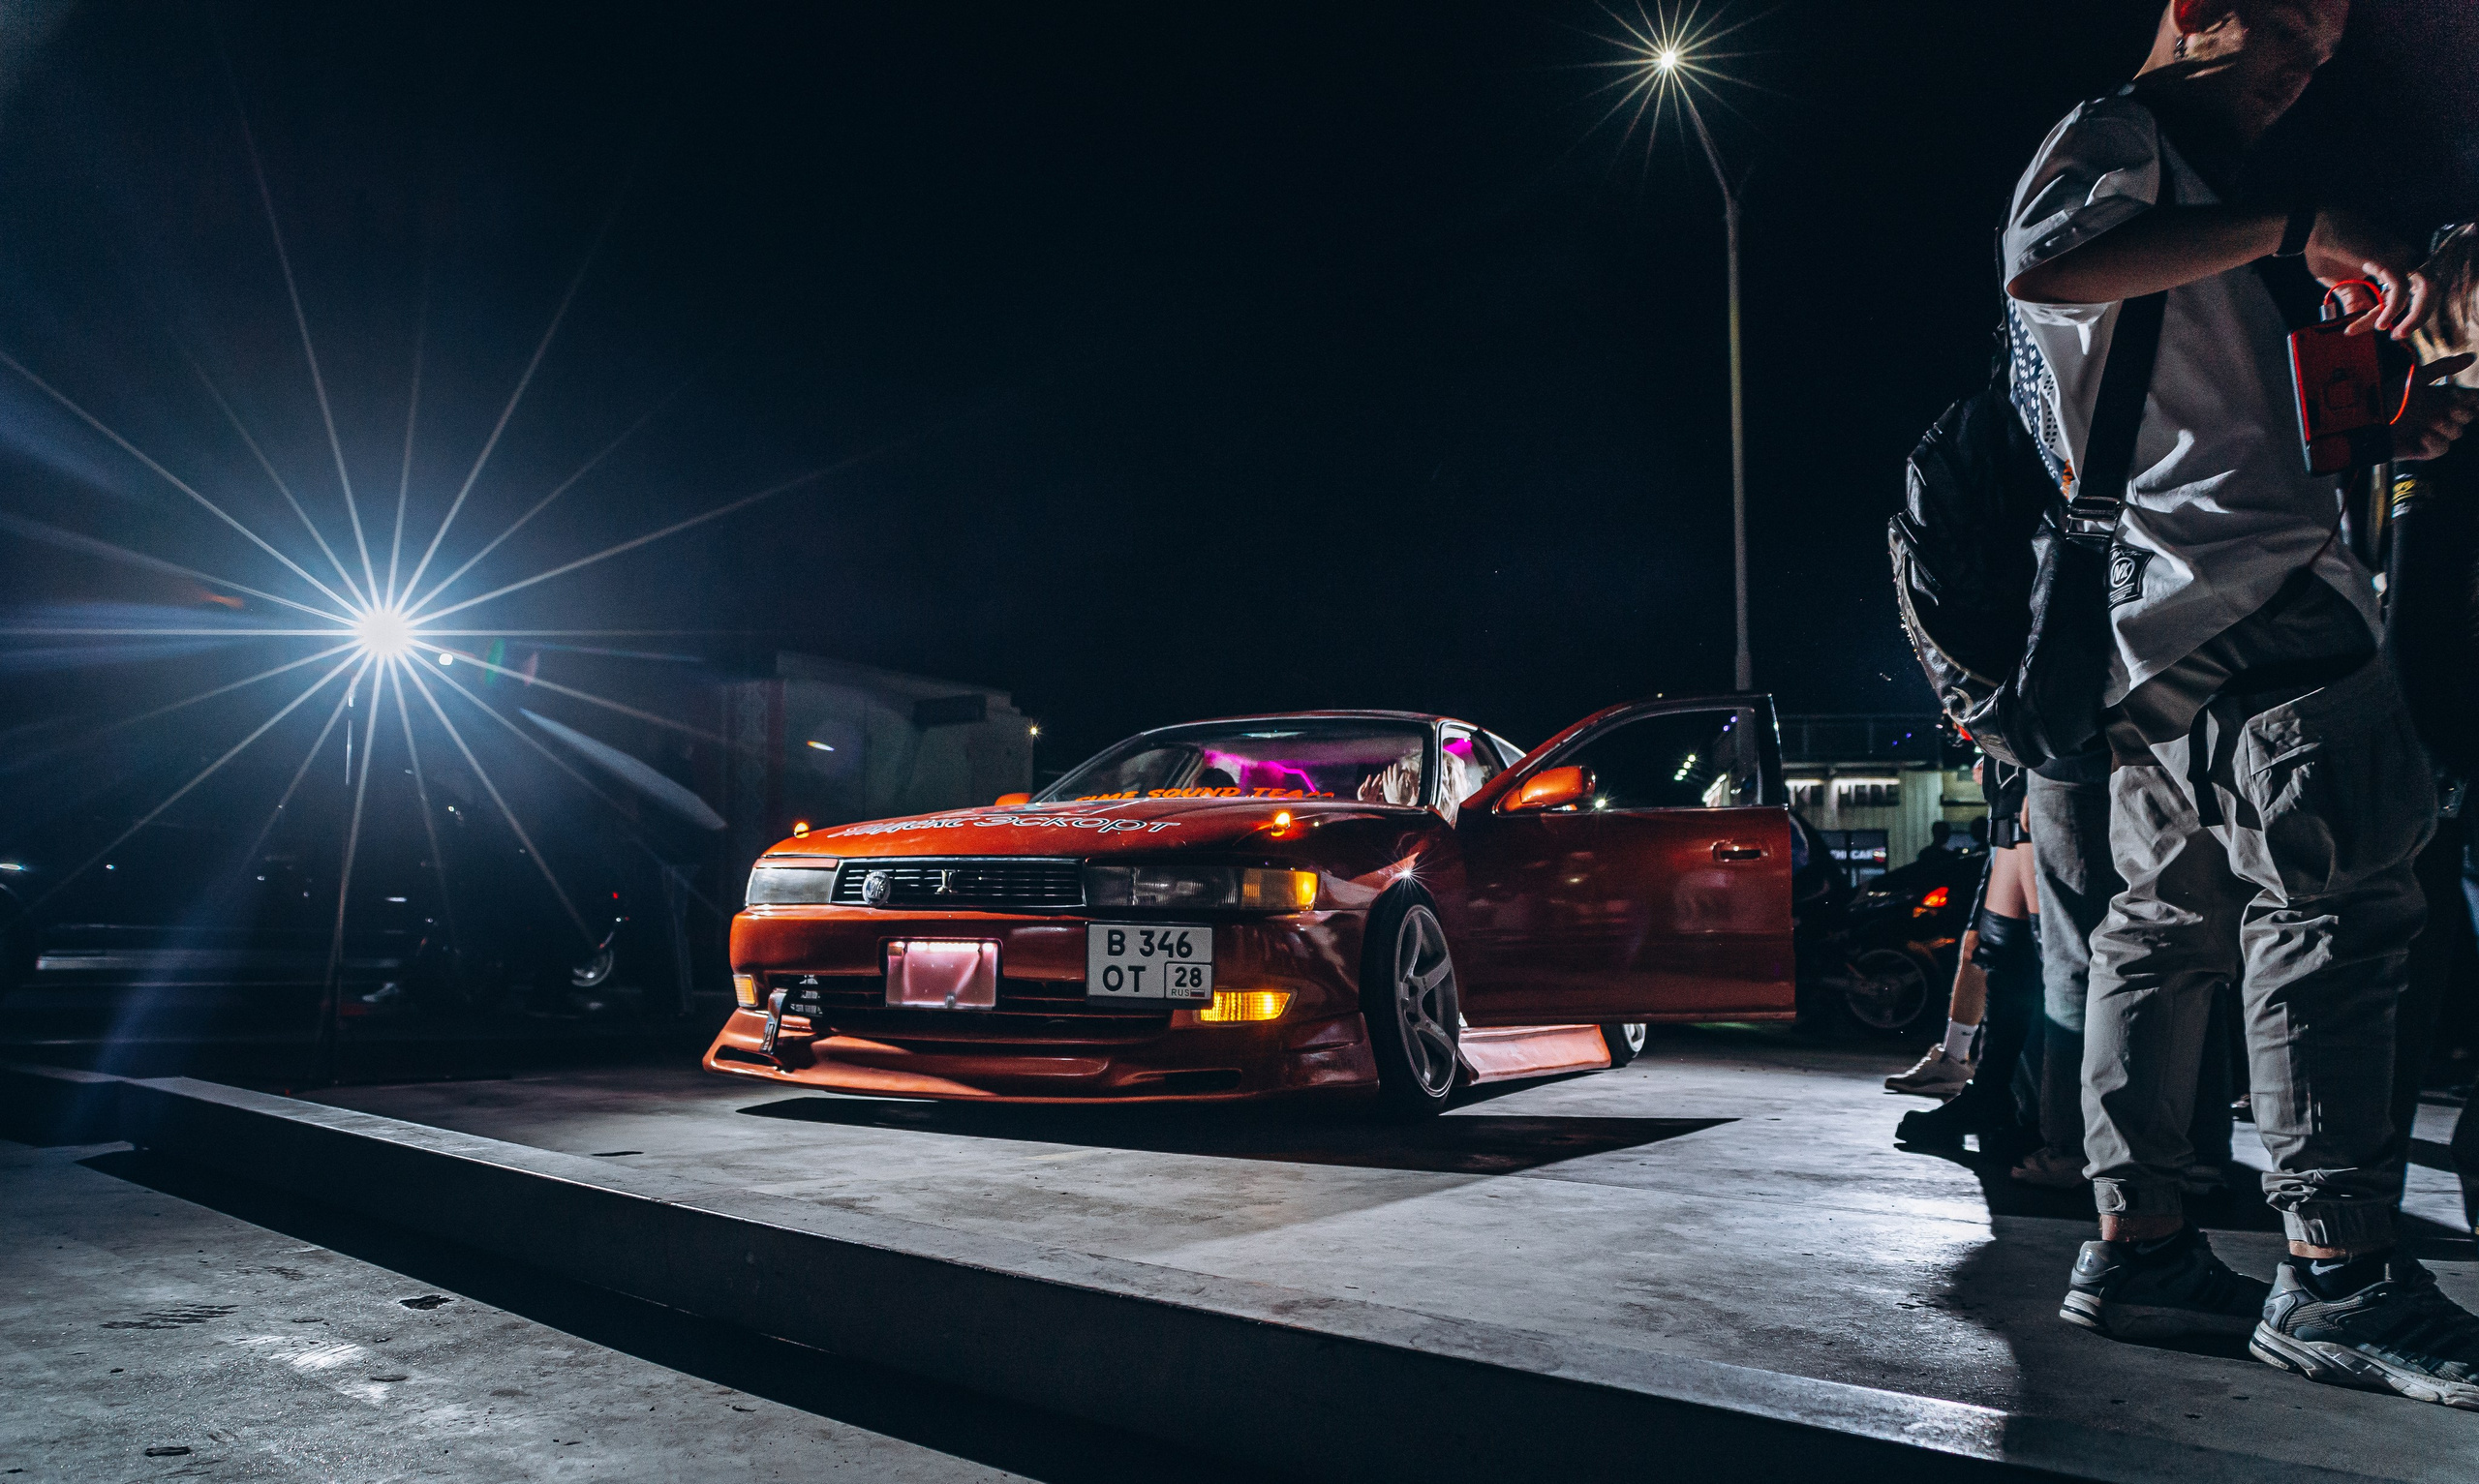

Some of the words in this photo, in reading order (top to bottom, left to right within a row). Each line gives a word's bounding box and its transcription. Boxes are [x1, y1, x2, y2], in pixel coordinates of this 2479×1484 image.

[1148, 786, 1241, 799] SOUND
[973, 815, 1181, 833] Эскорт
[1107, 929, 1125, 956] B
[1139, 930, 1193, 958] 346
[1102, 965, 1147, 993] OT
[1175, 966, 1203, 988] 28
[1171, 988, 1190, 997] RUS
